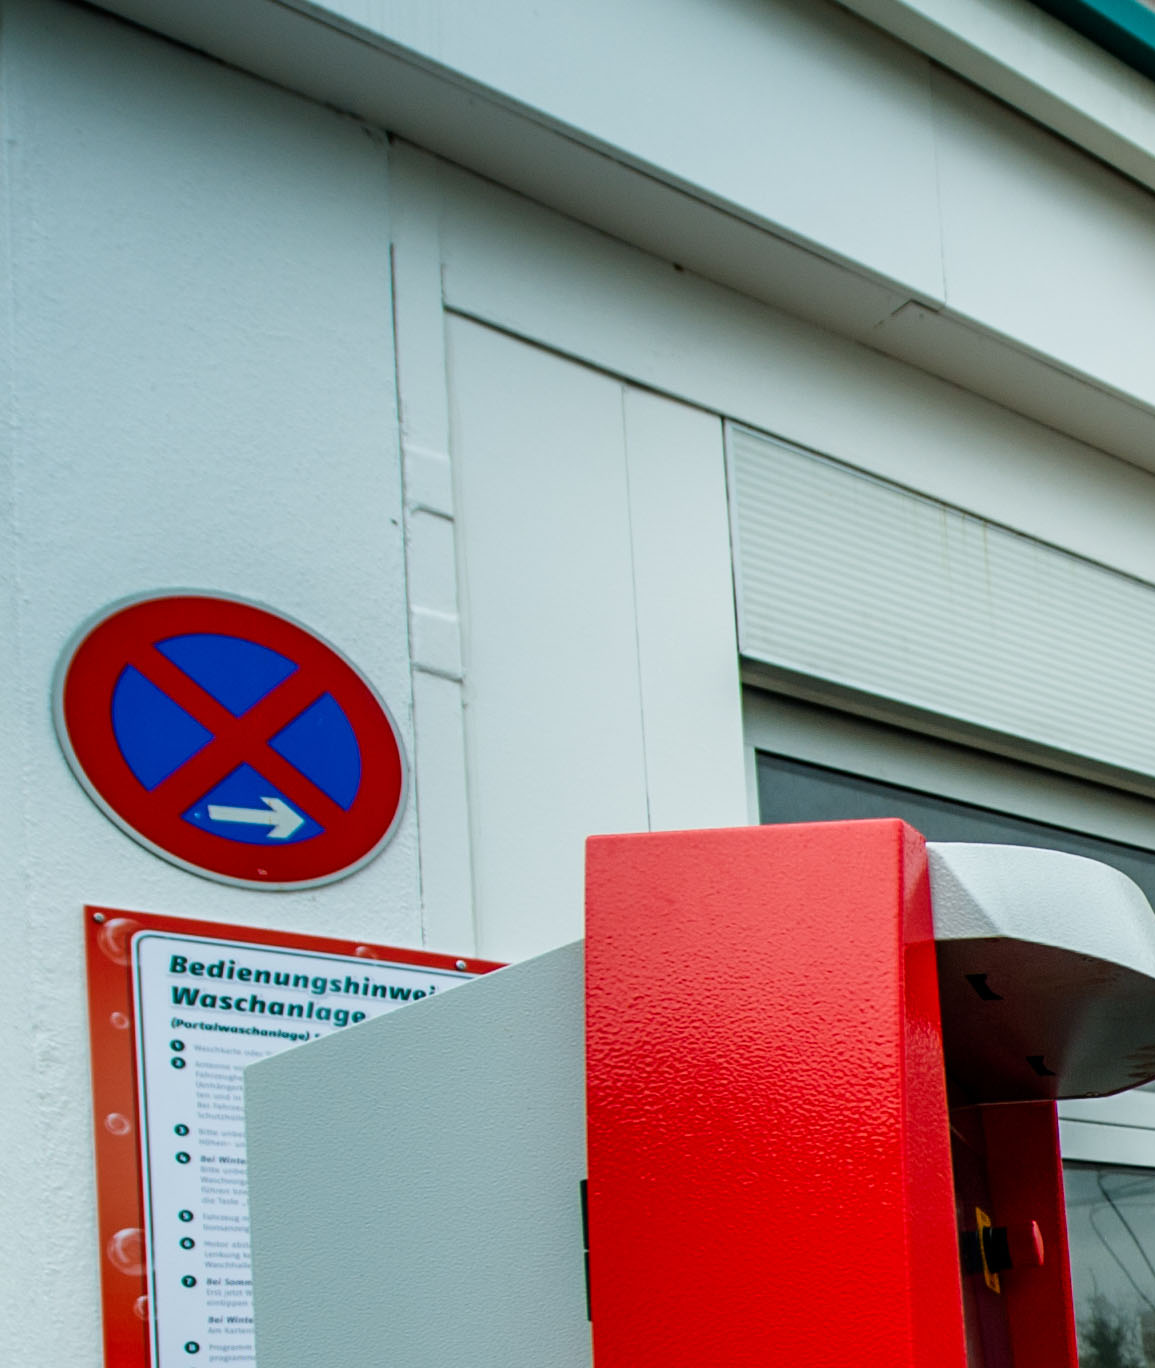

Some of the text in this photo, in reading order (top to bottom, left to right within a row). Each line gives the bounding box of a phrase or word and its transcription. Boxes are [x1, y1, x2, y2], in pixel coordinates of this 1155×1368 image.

[171, 986, 367, 1027] Waschanlage
[171, 1017, 310, 1041] (Portalwaschanlage)
[200, 1155, 215, 1164] Bei
[206, 1278, 221, 1287] Bei
[208, 1315, 223, 1325] Bei
